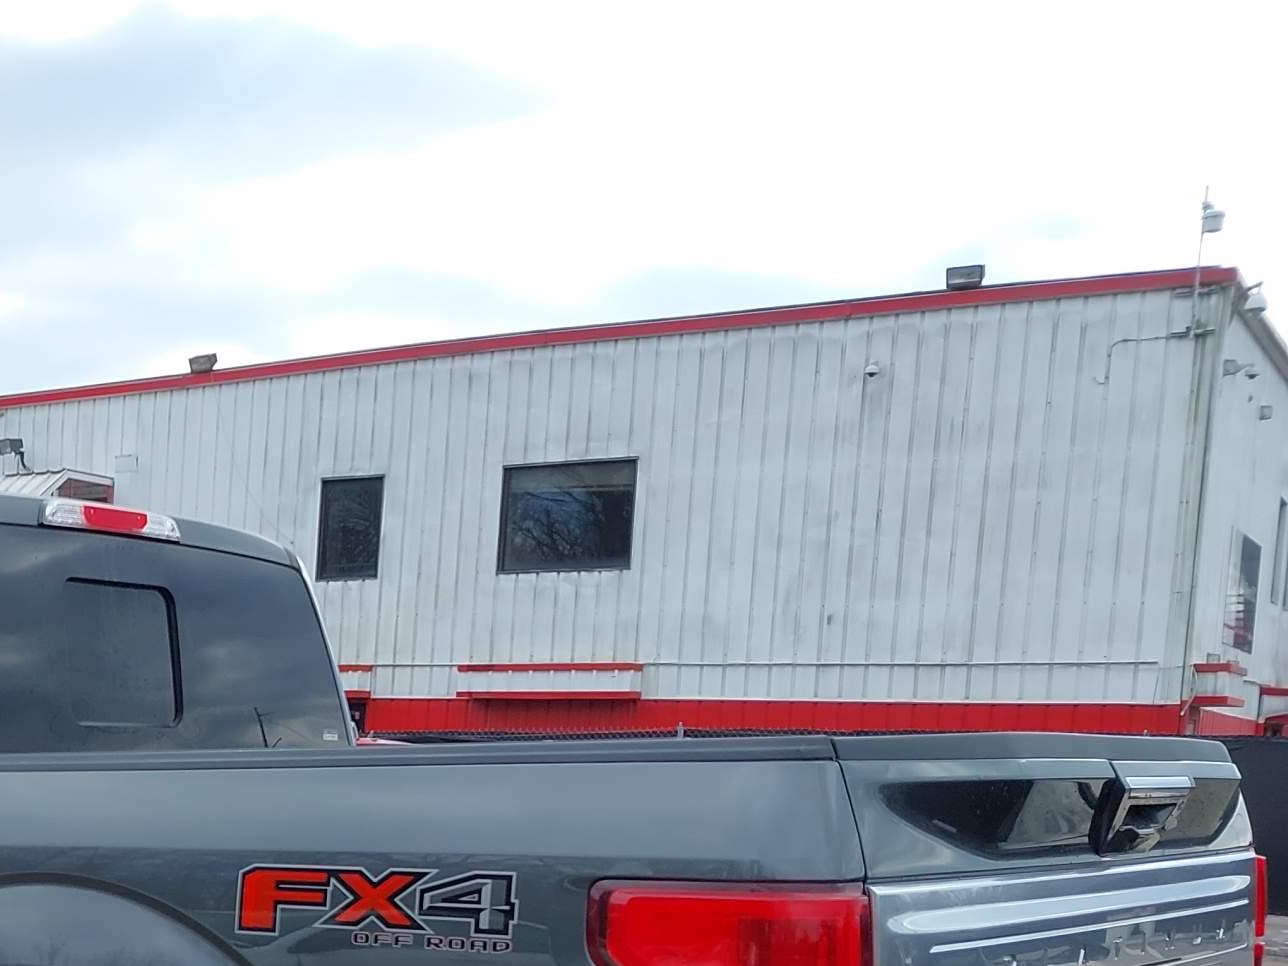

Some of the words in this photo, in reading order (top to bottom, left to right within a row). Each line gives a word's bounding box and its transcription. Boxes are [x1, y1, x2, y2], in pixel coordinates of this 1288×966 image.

[235, 863, 519, 938] FX4
[351, 931, 412, 948] OFF
[424, 935, 512, 954] ROAD
